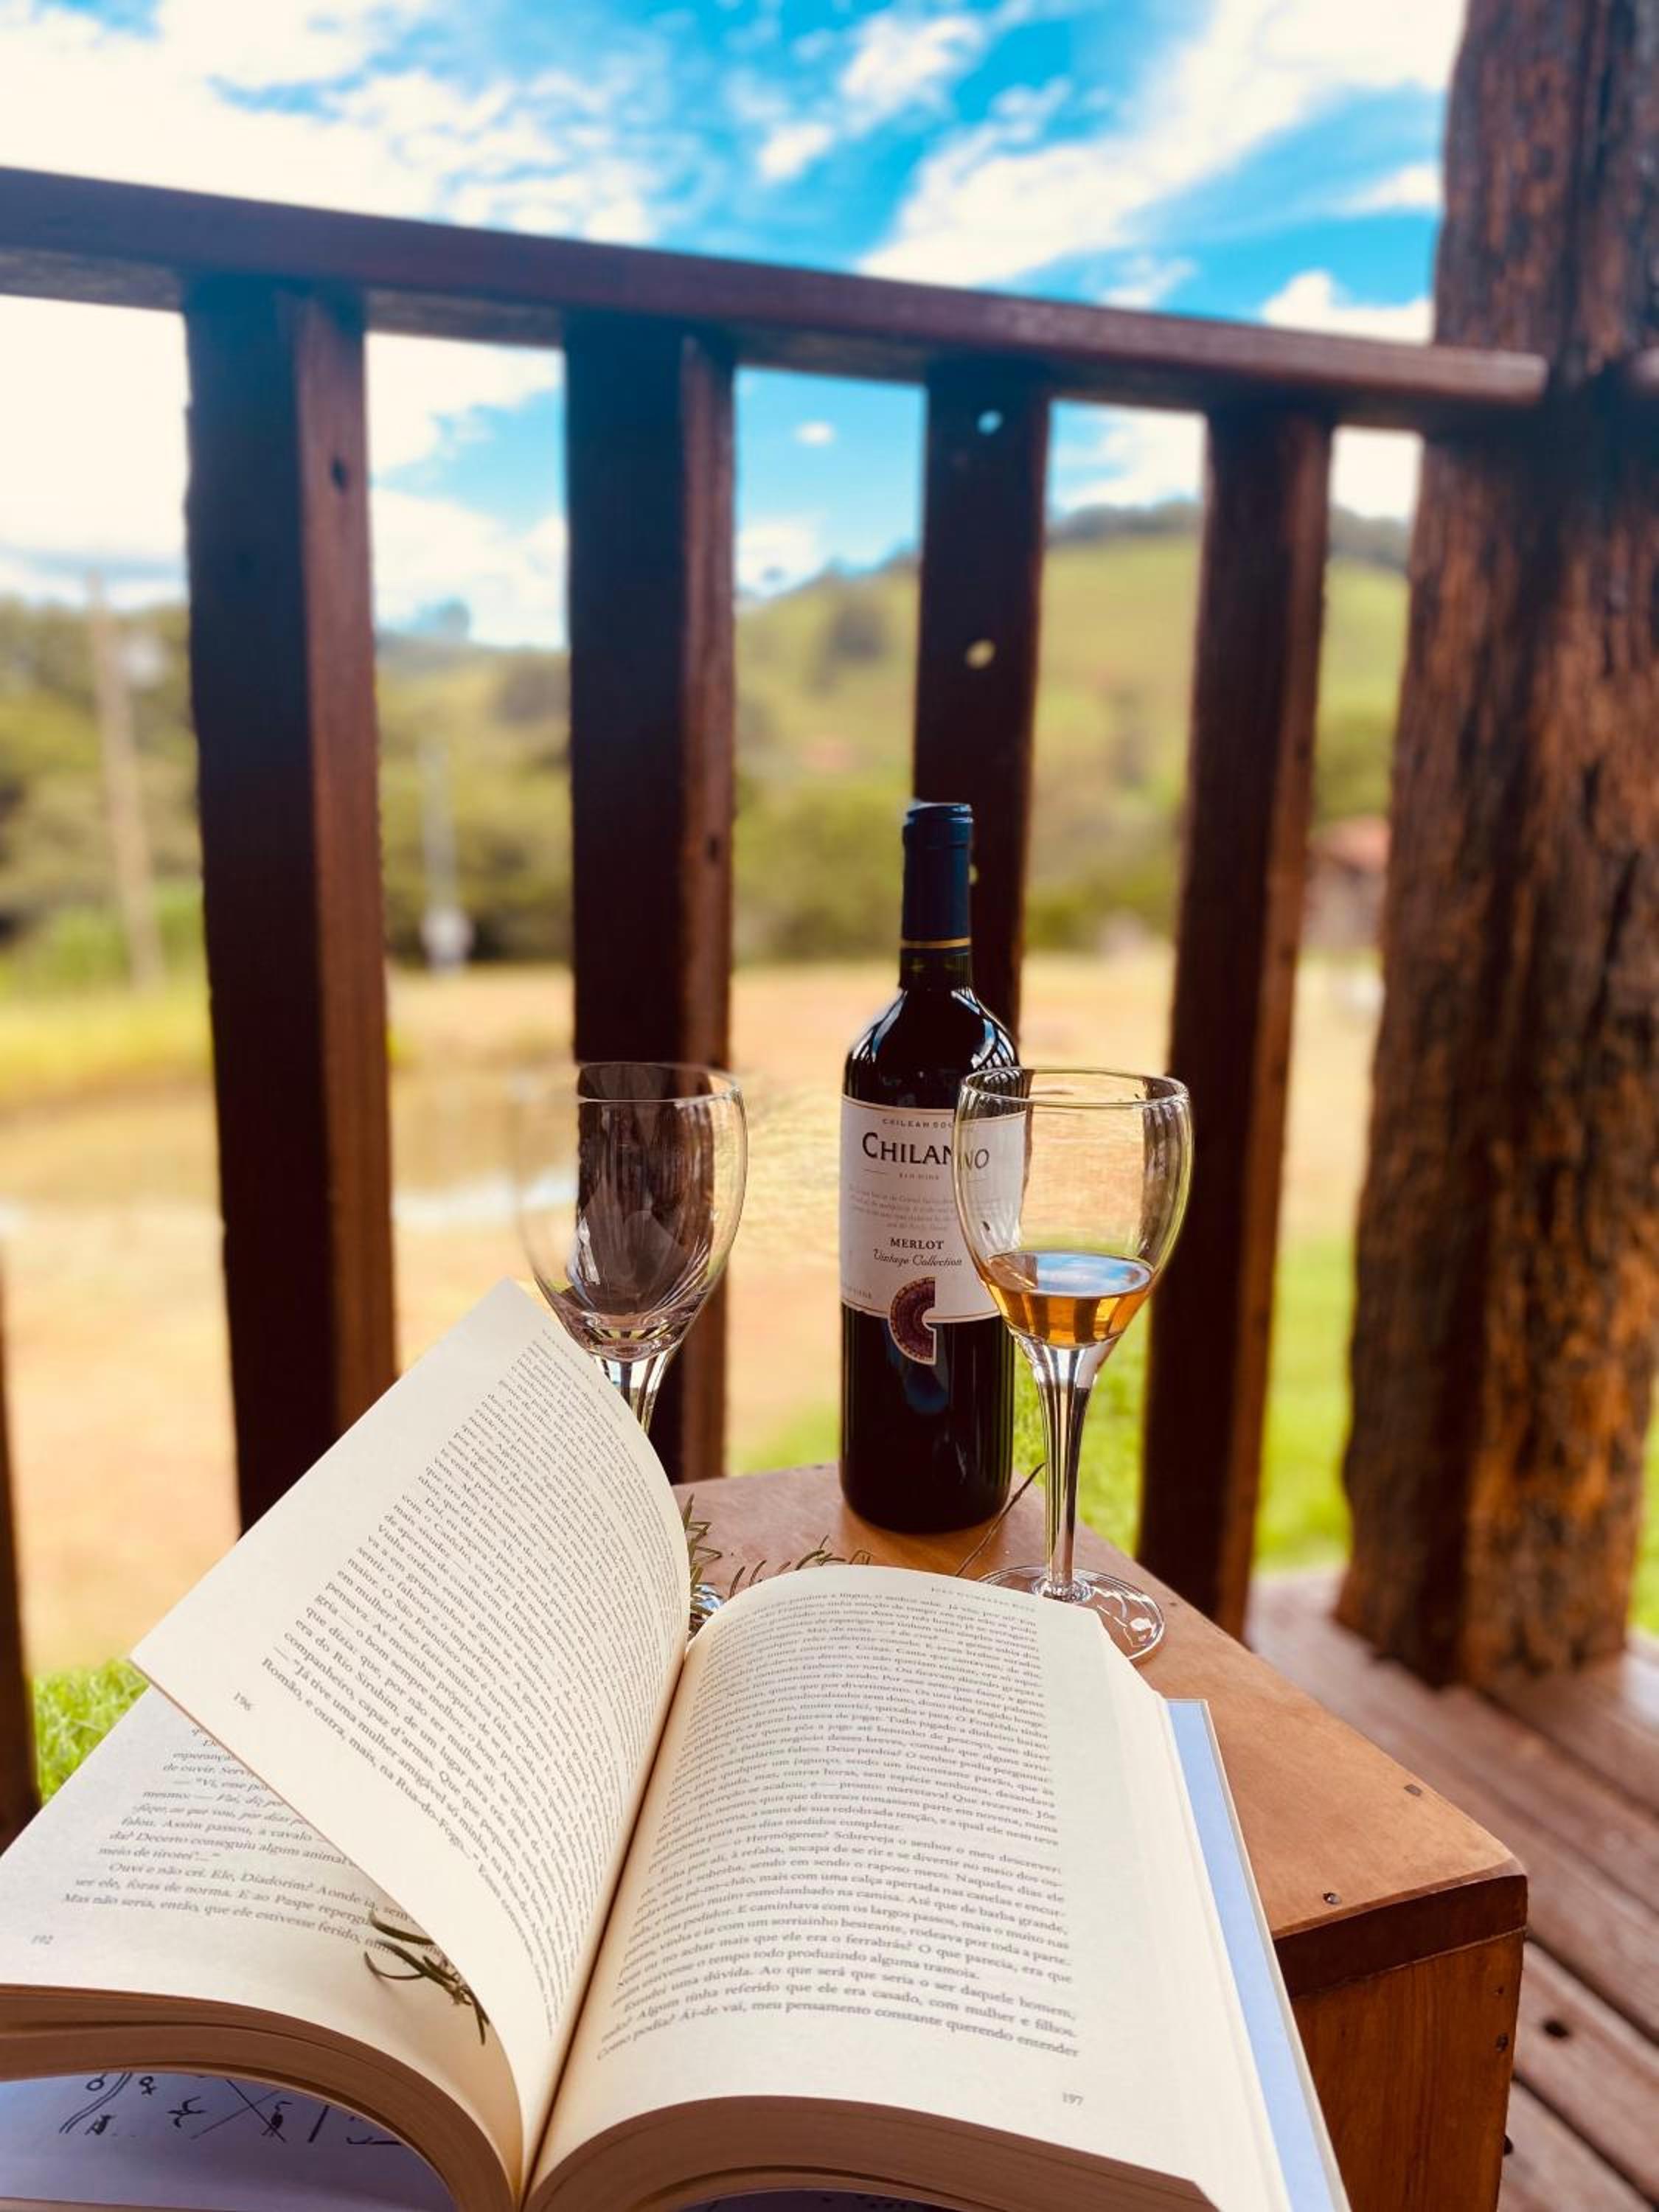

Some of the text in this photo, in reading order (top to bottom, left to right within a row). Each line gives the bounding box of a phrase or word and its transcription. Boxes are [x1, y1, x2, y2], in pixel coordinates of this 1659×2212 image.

[873, 1248, 962, 1267] Vintage Collection
[891, 1238, 944, 1249] MERLOT
[338, 1571, 353, 1586] em
[382, 1588, 392, 1599] O
[395, 1599, 413, 1618] São
[315, 1595, 338, 1615] gria
[356, 1629, 364, 1638] o
[365, 1635, 389, 1660] bom
[391, 1660, 428, 1694] sempre
[389, 1638, 436, 1681] mocinhas
[284, 1632, 354, 1700] companheiro,
[358, 1699, 389, 1728] capaz
[296, 1619, 313, 1637] era
[316, 1637, 329, 1652] do
[333, 1652, 353, 1672] Rio
[404, 1716, 418, 1729] de
[420, 1731, 437, 1748] um
[306, 1607, 327, 1627] que
[361, 1655, 381, 1678] que,
[385, 1677, 406, 1696] por
[408, 1697, 427, 1716] não
[431, 1717, 445, 1731] ter
[262, 1658, 302, 1702] Romão,
[314, 1707, 346, 1739] outra,
[380, 1765, 394, 1780] na
[310, 1679, 397, 1757] tive uma mulher
[134, 1848, 150, 1857] de
[135, 1832, 188, 1843] Decerto
[258, 1842, 299, 1857] algum
[302, 1849, 347, 1865] animal
[911, 1839, 951, 1852] senhor
[969, 1848, 995, 1860] meu
[108, 1864, 144, 1874] Ouvi
[157, 1865, 182, 1875] não
[316, 1883, 361, 1904] Aonde
[164, 1882, 181, 1891] de
[237, 1890, 251, 1899] E
[759, 1873, 787, 1882] mais
[790, 1872, 817, 1880] com
[821, 1874, 847, 1882] uma
[886, 1878, 939, 1893] apertada
[956, 1874, 1013, 1893] Naqueles
[1046, 1892, 1064, 1902] ele
[63, 1893, 89, 1903] Mas
[92, 1895, 118, 1905] não
[204, 1905, 233, 1916] que
[232, 1907, 252, 1917] ele
[319, 1922, 361, 1944] ferido,
[750, 1902, 818, 1912] caminhava
[822, 1902, 850, 1911] com
[871, 1904, 910, 1919] largos
[914, 1913, 958, 1928] passos,
[962, 1919, 991, 1933] mais
[1006, 1927, 1044, 1944] muito
[857, 1891, 903, 1902] camisa.
[935, 1901, 957, 1912] que
[961, 1903, 977, 1914] de
[979, 1907, 1015, 1922] barba
[1018, 1916, 1068, 1935] grande,
[754, 1949, 784, 1959] todo
[788, 1948, 866, 1962] produzindo
[870, 1955, 919, 1970] alguma
[909, 1927, 961, 1943] rodeava
[965, 1938, 987, 1949] por
[991, 1942, 1020, 1955] toda
[918, 1944, 932, 1954] O
[936, 1947, 960, 1959] que
[965, 1952, 1018, 1972] parecia,
[1022, 1966, 1043, 1977] era
[1048, 1969, 1072, 1983] que
[685, 1988, 719, 2003] tinha
[725, 1983, 779, 1995] referido
[786, 1983, 812, 1994] que
[818, 1983, 838, 1993] ele
[844, 1986, 866, 1996] era
[872, 1987, 922, 2006] casado,
[929, 1999, 959, 2011] com
[965, 2003, 1015, 2024] mulher
[1020, 2017, 1029, 2026] e
[704, 1964, 1077, 2021] dúvida. Ao que será que seria o ser daquele homem,
[723, 2001, 1079, 2057] vai, meu pensamento constante querendo entender
[1062, 2092, 1084, 2107] 197
